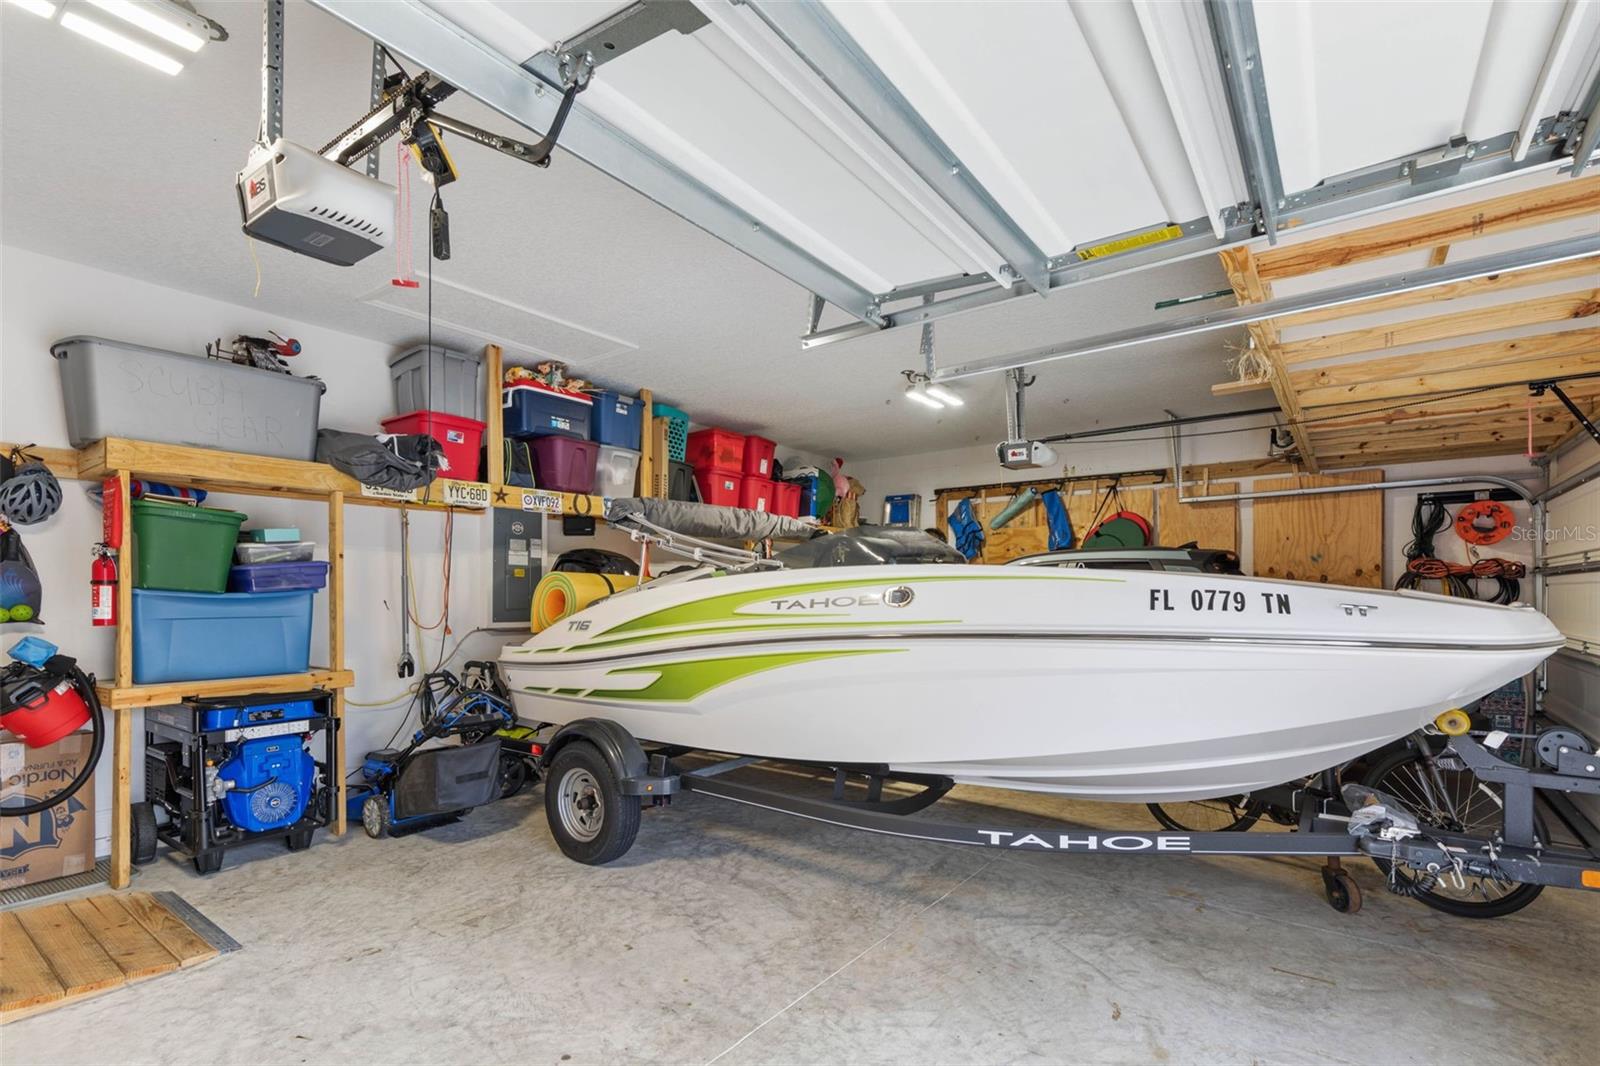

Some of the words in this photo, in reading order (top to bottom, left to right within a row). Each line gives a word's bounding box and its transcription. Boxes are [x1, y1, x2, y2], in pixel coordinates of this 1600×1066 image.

[119, 359, 246, 414] SCUBA
[194, 410, 284, 449] GEAR
[771, 596, 879, 610] TAHOE
[1150, 589, 1175, 611] FL
[1191, 589, 1246, 612] 0779
[1261, 592, 1292, 615] TN
[9, 767, 77, 787] Nordic
[977, 829, 1191, 851] TAHOE
